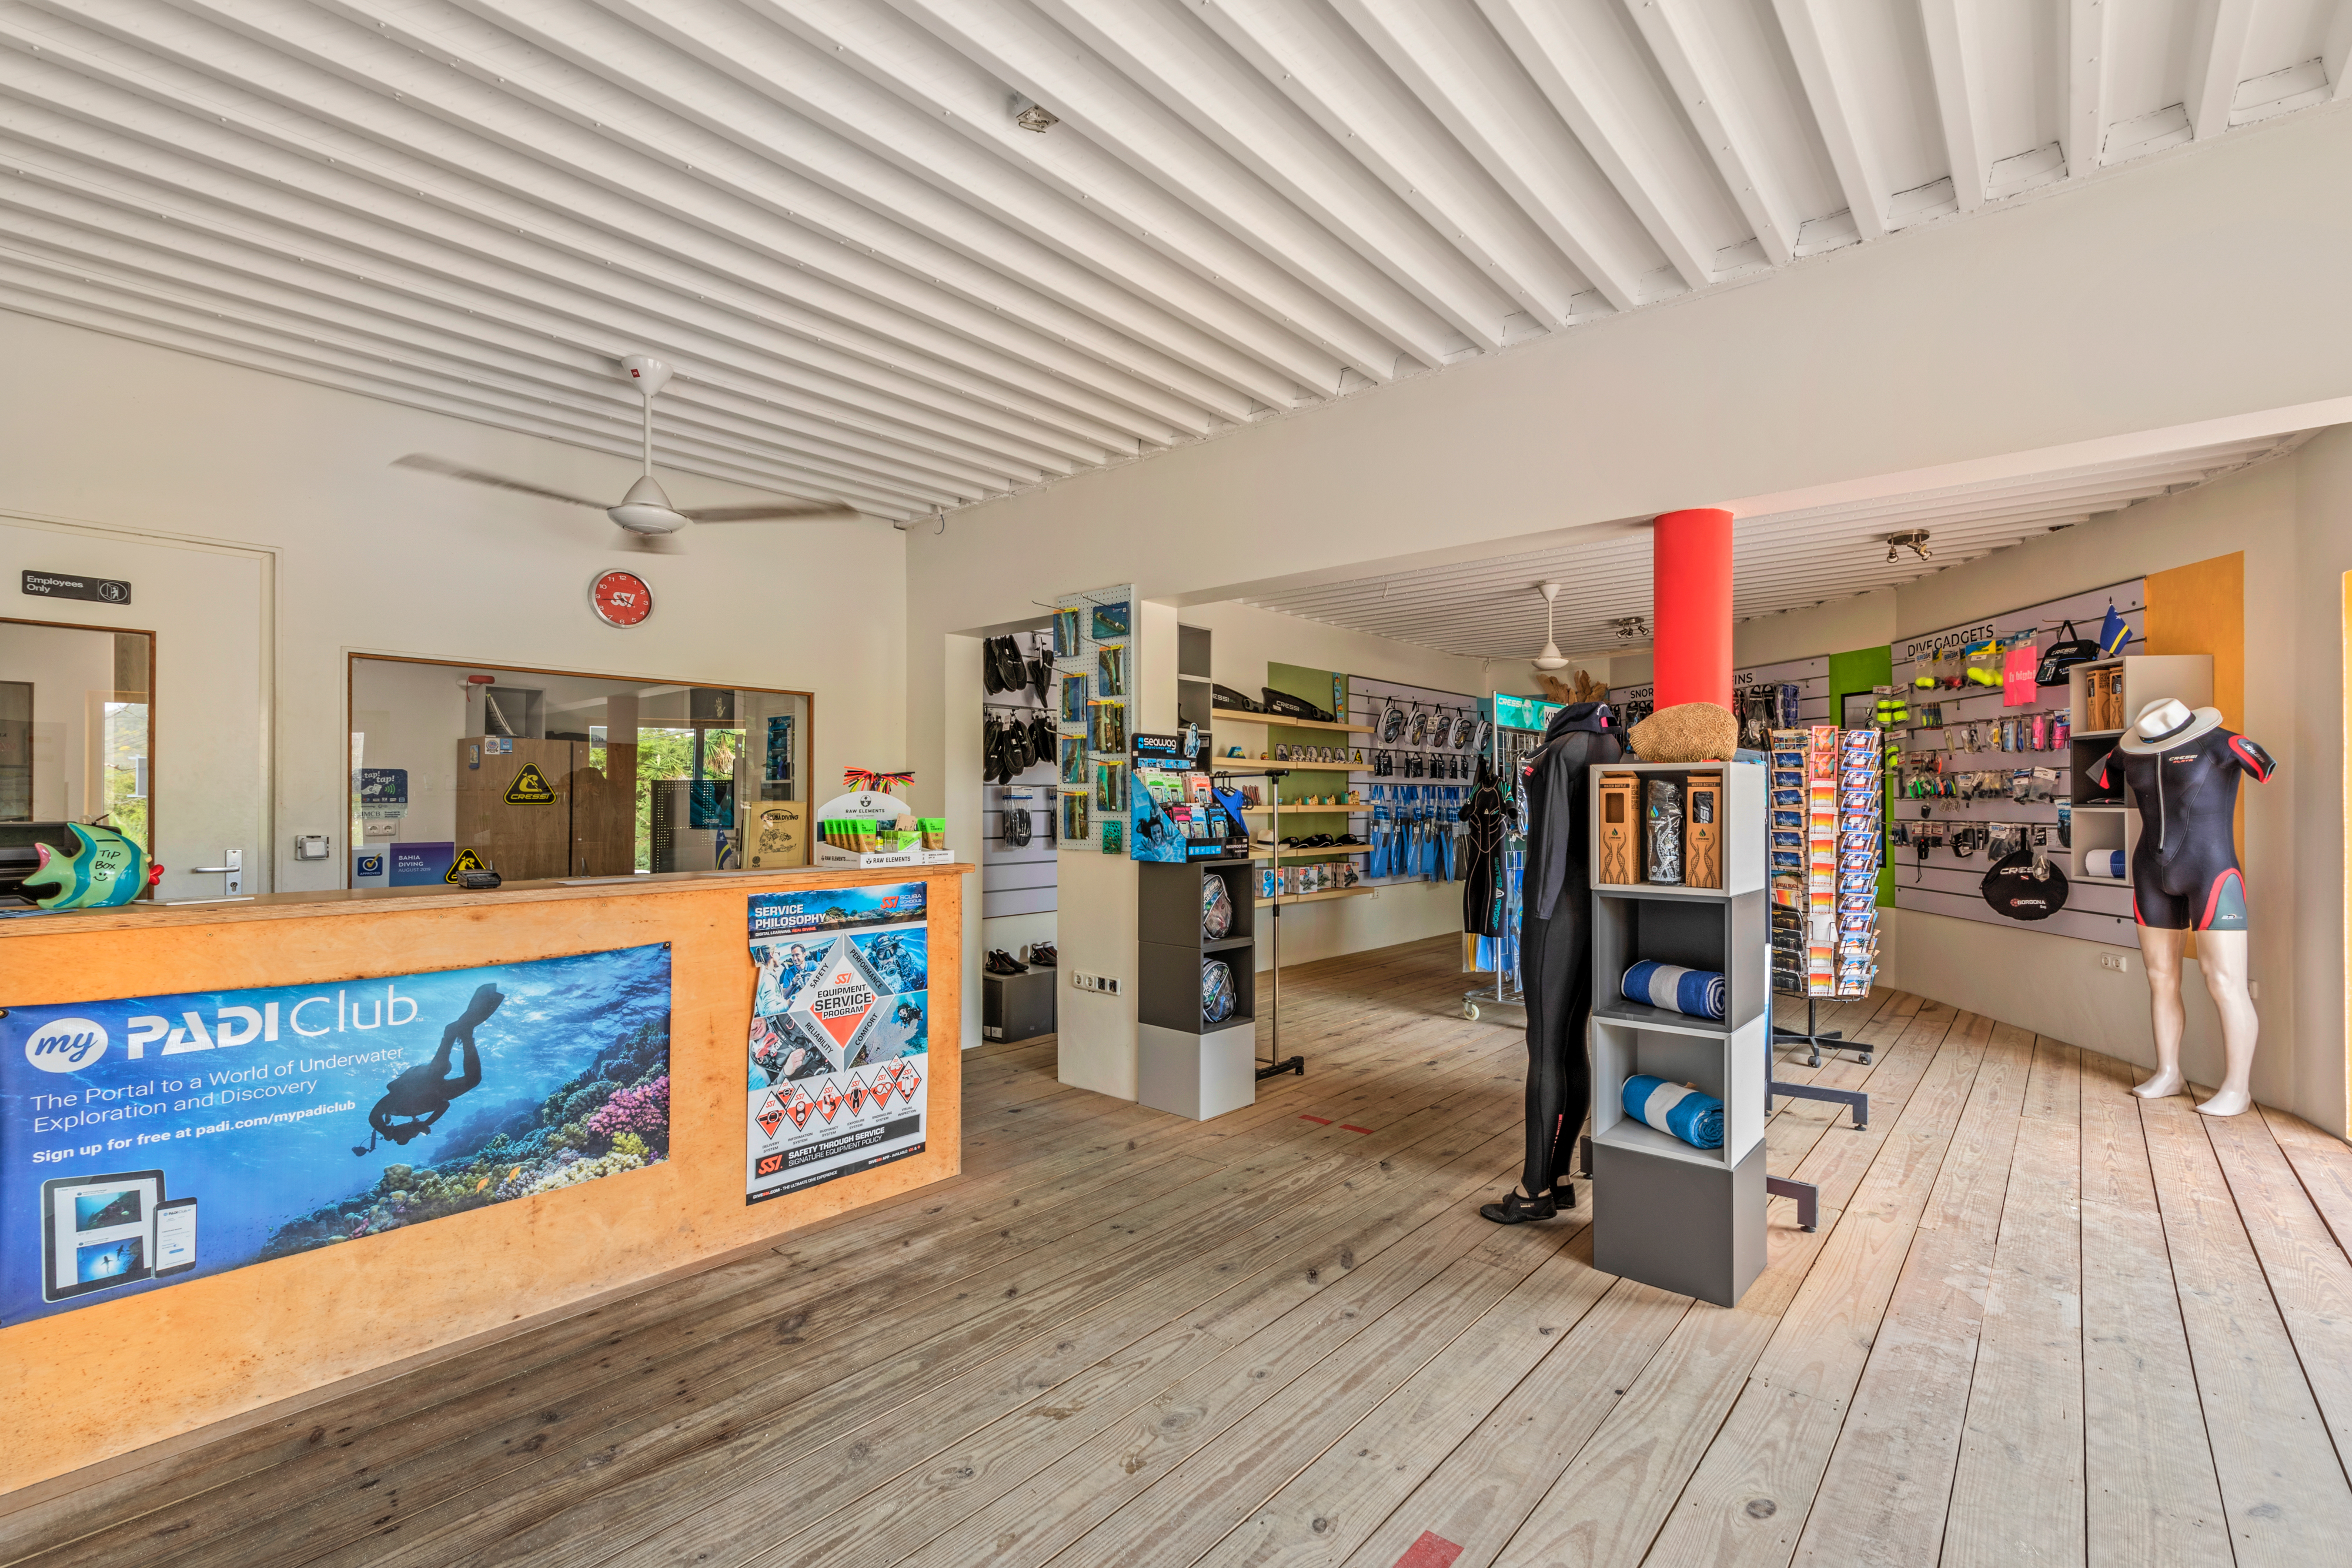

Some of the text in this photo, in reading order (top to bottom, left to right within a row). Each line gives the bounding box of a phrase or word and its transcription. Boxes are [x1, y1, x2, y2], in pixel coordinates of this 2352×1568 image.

[26, 575, 83, 588] Employees
[26, 583, 51, 593] Only
[610, 591, 636, 607] SSI
[1934, 624, 1993, 650] GADGETS
[2051, 647, 2078, 656] CRESSI
[1732, 673, 1753, 685] INS
[1212, 693, 1230, 703] ESSI
[1630, 687, 1654, 698] SNOR
[1276, 700, 1300, 712] CRESSI
[1498, 697, 1522, 708] CRESSI
[1144, 738, 1177, 750] seawag
[2241, 743, 2265, 763] CRESSI
[364, 771, 380, 779] tap!
[376, 775, 395, 784] tap!
[99, 850, 121, 860] TIP
[95, 861, 116, 870] BOX
[2000, 867, 2034, 875] CRES
[880, 895, 899, 909] SSI
[754, 904, 804, 918] SERVICE
[754, 913, 827, 930] PHILOSOPHY
[850, 948, 883, 989] PERFORMANCE
[810, 962, 829, 989] SAFETY
[834, 972, 852, 985] SSI
[817, 984, 867, 998] EQUIPMENT
[815, 992, 872, 1011] SERVICE
[823, 1005, 863, 1018] PROGRAM
[35, 984, 418, 1063] my PADI Club
[855, 1012, 878, 1046] COMFORT
[804, 1022, 834, 1054] RELIABILITY
[31, 1047, 404, 1111] The Portal to a World of Underwater
[34, 1079, 318, 1133] Exploration and Discovery
[766, 1100, 776, 1108] SSI
[872, 1111, 893, 1119] SNORKELING
[32, 1100, 356, 1164] Sign up for free at padi.com/mypadiclub
[819, 1125, 838, 1134] BUOYANCY
[788, 1132, 813, 1142] INFORMATION
[789, 1126, 885, 1159] SAFETY THROUGH SERVICE
[762, 1141, 780, 1149] DELIVERY
[789, 1135, 883, 1166] SIGNATURE EQUIPMENT POLICY
[753, 1188, 780, 1199] DIVESSI.COM
[790, 1179, 808, 1188] ULTIMATE
[817, 1170, 838, 1181] EXPERIENCE
